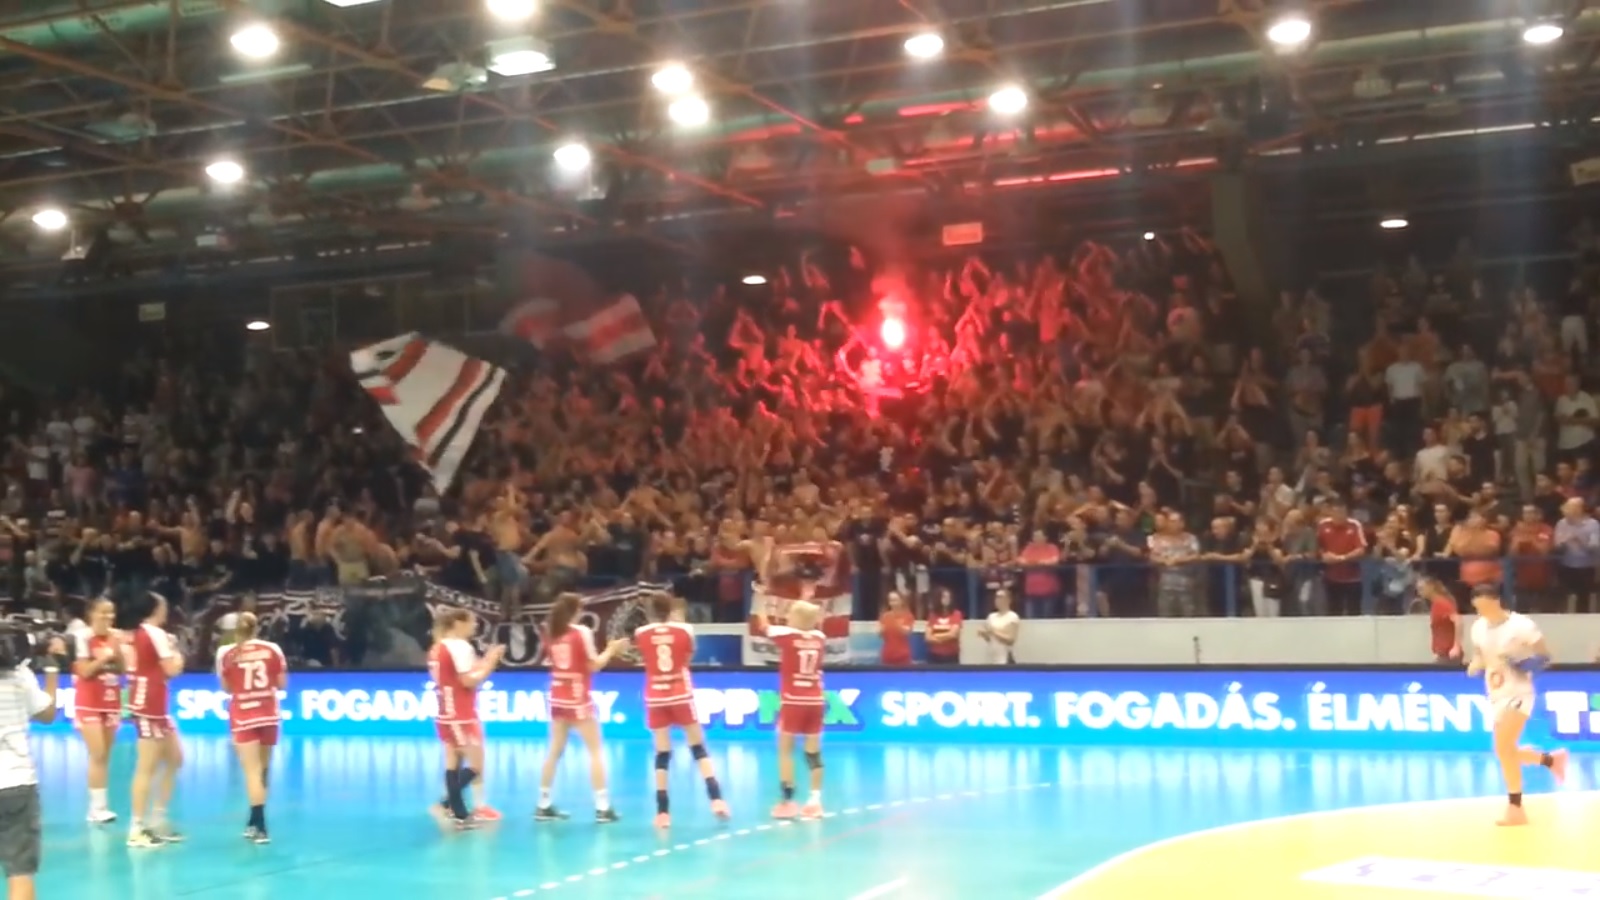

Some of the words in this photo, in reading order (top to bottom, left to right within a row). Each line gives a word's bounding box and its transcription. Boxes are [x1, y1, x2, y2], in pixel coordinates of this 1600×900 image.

[656, 645, 674, 672] 8
[797, 650, 819, 674] 17
[238, 660, 268, 689] 73
[177, 689, 292, 720] SPO.
[301, 681, 439, 721] FOGADÁ
[477, 681, 626, 722] ÉLMY.
[880, 690, 1041, 728] SPORT.
[1053, 681, 1296, 731] FOGADÁS.
